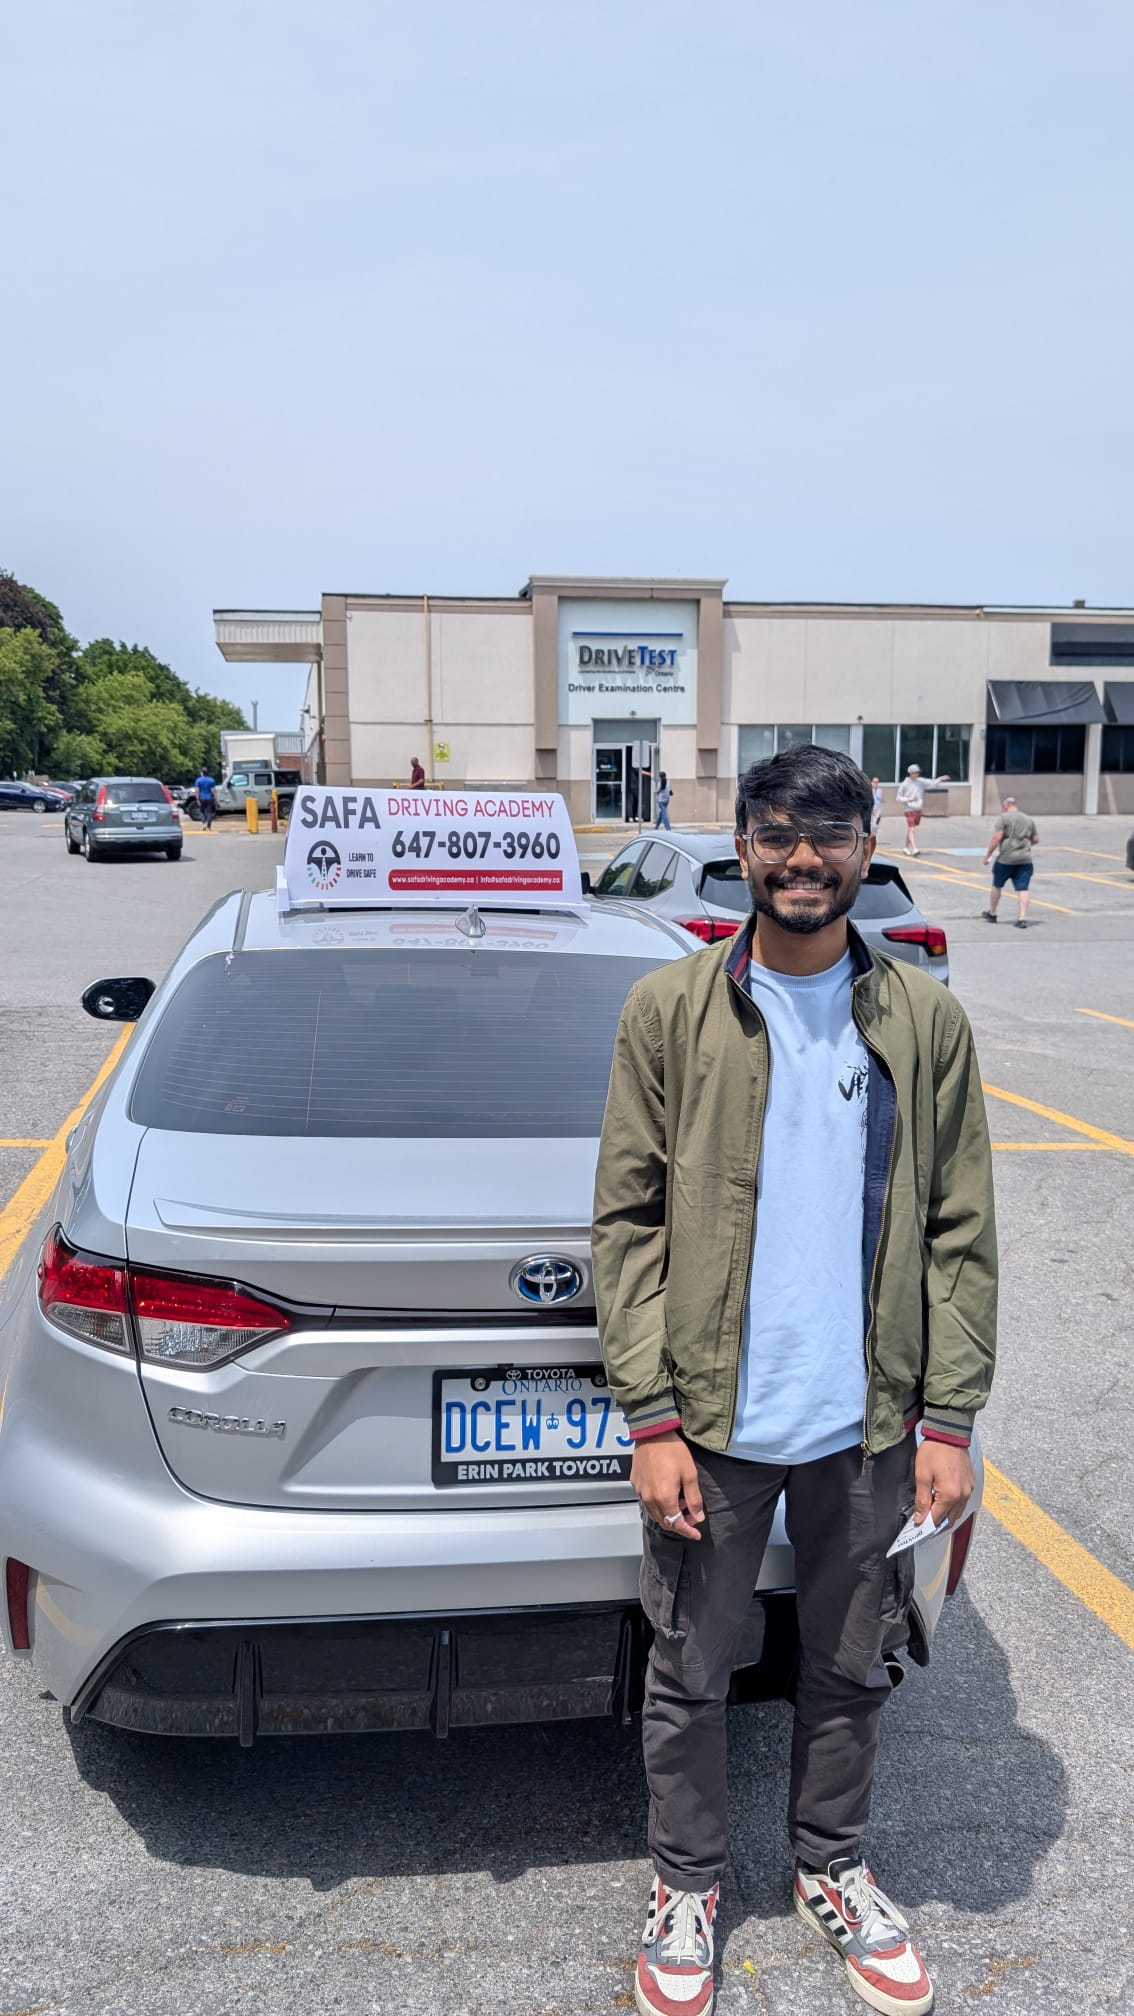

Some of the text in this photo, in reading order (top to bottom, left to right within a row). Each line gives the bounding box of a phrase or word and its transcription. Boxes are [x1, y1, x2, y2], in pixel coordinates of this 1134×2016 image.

[568, 683, 685, 693] Driver Examination Centre
[300, 795, 555, 829] SAFA DRIVING ACADEMY
[391, 831, 561, 860] 647-807-3960
[349, 853, 374, 862] LEARN TO
[346, 869, 376, 878] DRIVE SAFE
[392, 875, 561, 884] www.safadrivingacademy.ca info@safadrivingacademy.ca
[526, 1368, 576, 1380] TOYOTA
[502, 1378, 582, 1395] ONTARIO
[168, 1406, 287, 1440] COROLLA
[445, 1398, 541, 1453] DCEW
[457, 1459, 622, 1480] ERIN PARK TOYOTA
